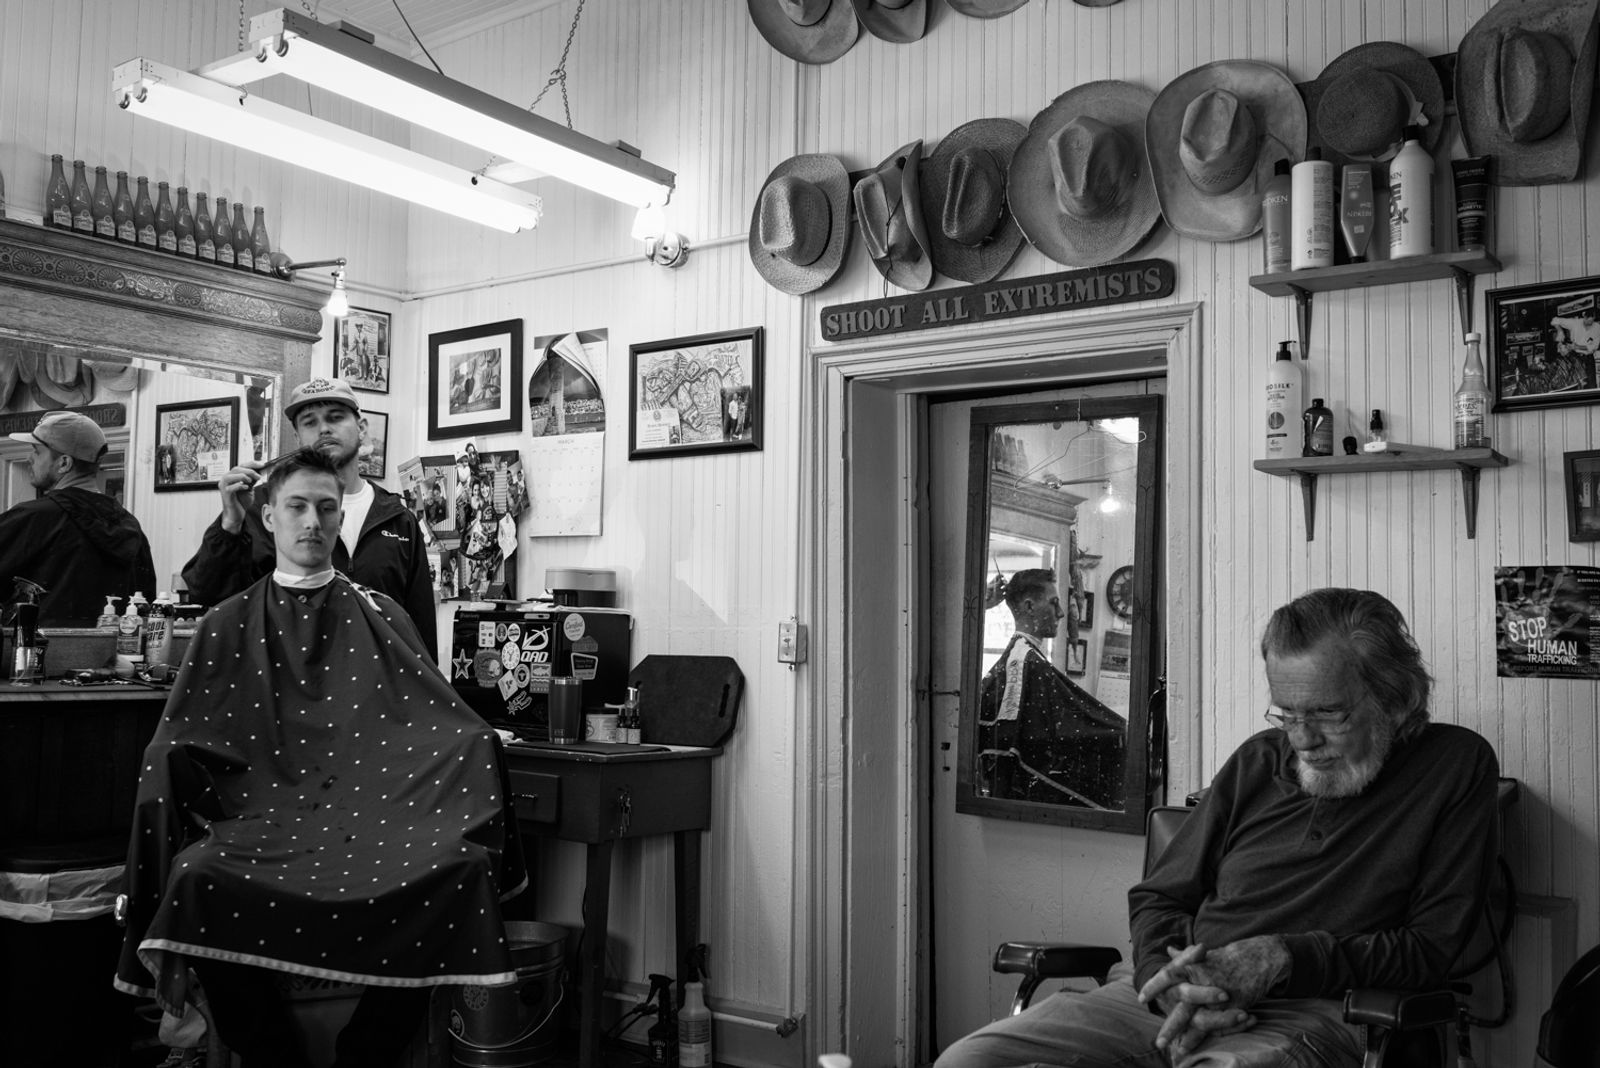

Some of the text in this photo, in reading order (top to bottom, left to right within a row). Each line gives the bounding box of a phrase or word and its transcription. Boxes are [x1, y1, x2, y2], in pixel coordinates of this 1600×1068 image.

[826, 267, 1161, 336] SHOOT ALL EXTREMISTS
[1508, 616, 1547, 642] STOP
[1527, 639, 1578, 656] HUMAN
[520, 651, 549, 663] QAD
[1527, 653, 1578, 665] TRAFFICKING
